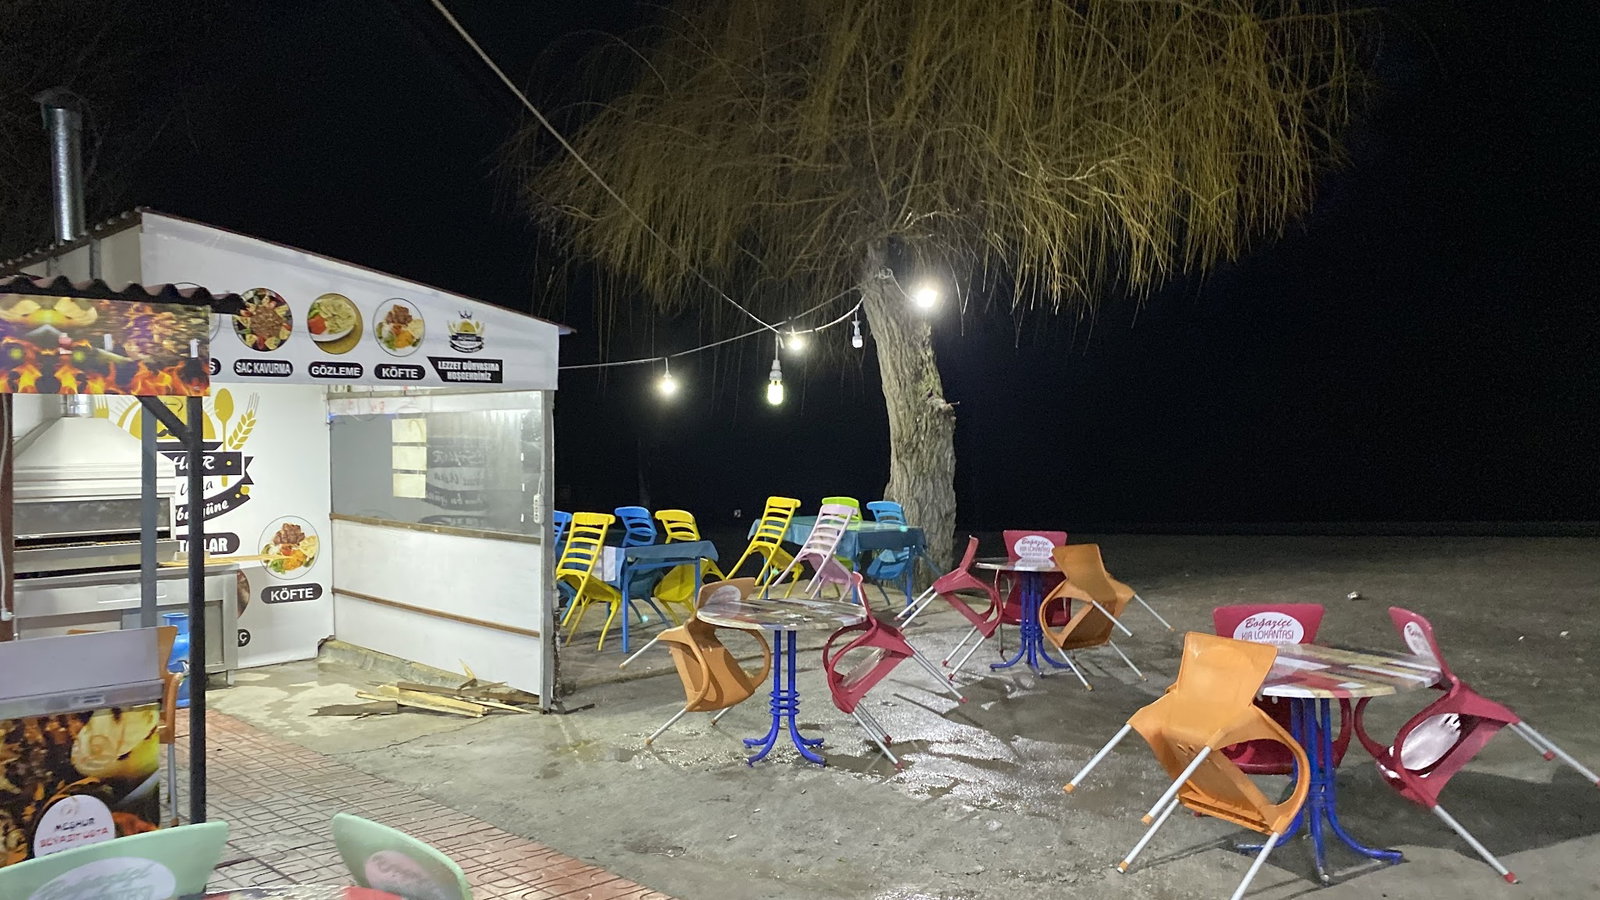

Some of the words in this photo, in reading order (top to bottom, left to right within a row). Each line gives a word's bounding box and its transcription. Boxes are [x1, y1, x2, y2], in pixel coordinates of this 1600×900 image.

[236, 362, 253, 373] SAC
[254, 363, 291, 374] KAVURMA
[311, 364, 361, 376] GÖZLEME
[438, 361, 461, 370] LEZZET
[382, 366, 419, 378] KÖFTE
[270, 587, 314, 601] KÖFTE
[1245, 618, 1293, 630] Boğaziçi
[1255, 629, 1294, 640] LOKANTASI
